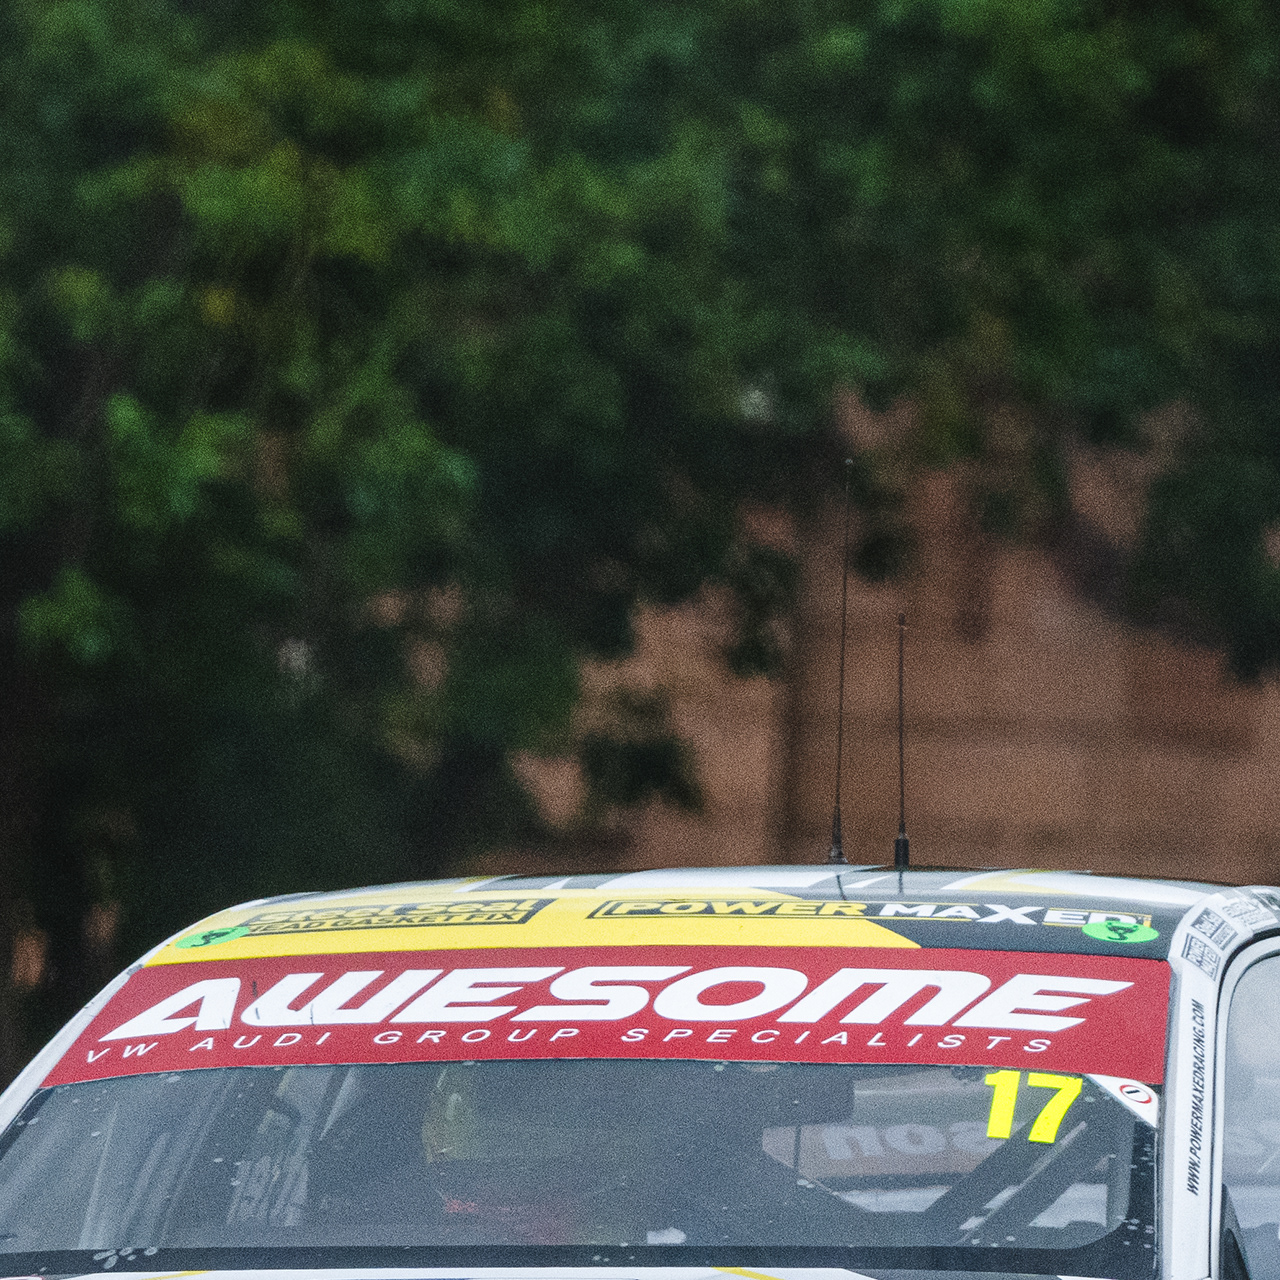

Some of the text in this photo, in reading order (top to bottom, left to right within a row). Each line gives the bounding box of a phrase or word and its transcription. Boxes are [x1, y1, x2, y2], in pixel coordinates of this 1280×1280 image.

[330, 914, 461, 928] GASKET
[465, 911, 521, 922] FIX
[619, 901, 868, 917] POWER
[99, 966, 1134, 1041] AWESOME
[86, 1028, 1052, 1063] VW AUDI GROUP SPECIALISTS
[985, 1069, 1084, 1144] 17
